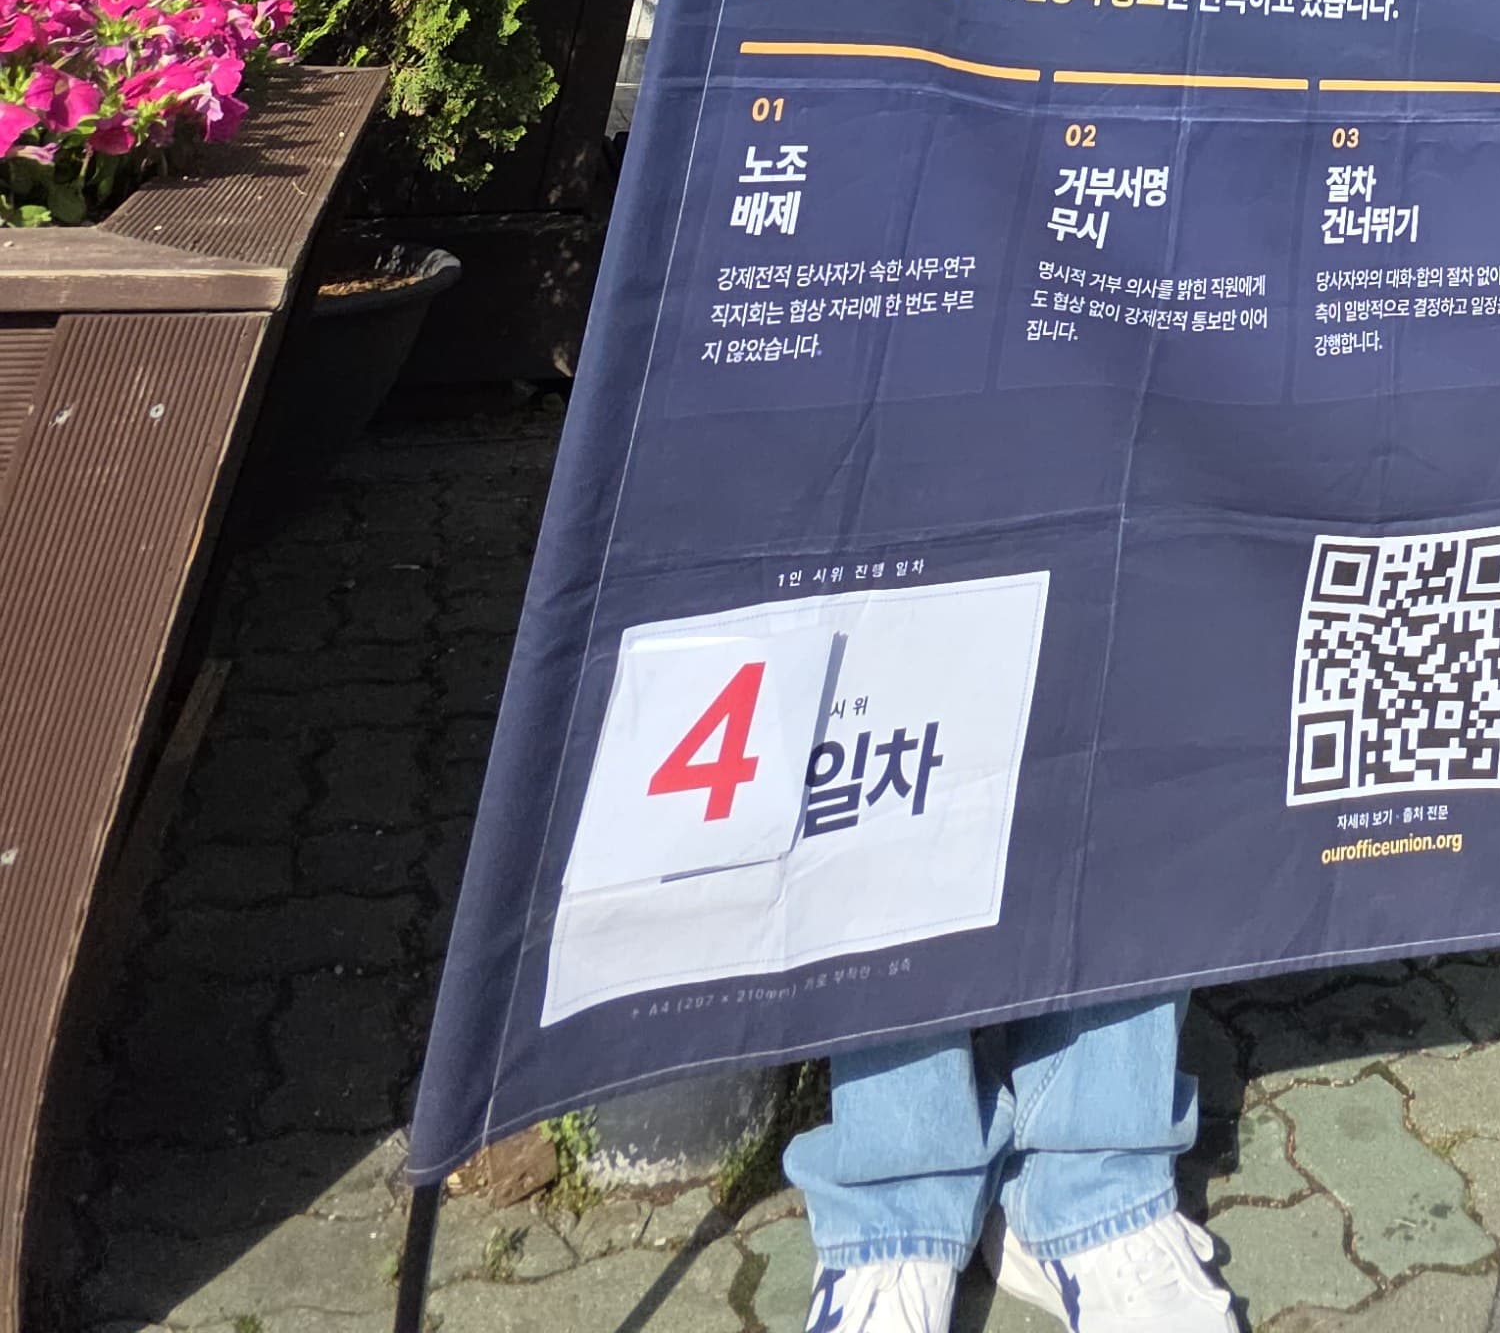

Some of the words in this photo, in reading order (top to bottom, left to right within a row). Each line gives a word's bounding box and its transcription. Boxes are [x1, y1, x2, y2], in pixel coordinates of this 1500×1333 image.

[751, 97, 784, 122] 01
[1065, 124, 1097, 148] 02
[1331, 128, 1360, 149] 03
[738, 144, 809, 184] 노조
[1054, 165, 1170, 208] 거부서명
[1325, 165, 1376, 204] 절차
[729, 190, 802, 236] 배제
[1047, 207, 1111, 250] 무시
[1320, 205, 1420, 245] 건너뛰기
[717, 263, 792, 291] 강제전적
[796, 261, 866, 290] 당사자가
[869, 258, 902, 284] 속한
[905, 255, 976, 279] 사무·연구
[1037, 260, 1086, 287] 명시적
[1089, 268, 1122, 295] 거부
[1125, 275, 1174, 301] 의사를
[1177, 276, 1208, 302] 밝힌
[1210, 273, 1267, 299] 직원에게
[1316, 267, 1383, 292] 당사자와의
[1385, 265, 1444, 290] 대화·합의
[1447, 265, 1474, 289] 절차
[711, 301, 785, 328] 직지회는
[789, 297, 827, 324] 협상
[828, 294, 881, 322] 자리에
[885, 293, 901, 319] 한
[905, 290, 938, 315] 번도
[941, 289, 975, 312] 부르
[1031, 290, 1050, 310] 도
[1053, 293, 1086, 315] 협상
[1089, 299, 1120, 323] 없이
[1125, 304, 1188, 332] 강제전적
[1191, 307, 1237, 332] 통보만
[1240, 305, 1268, 330] 이어
[1315, 299, 1342, 324] 측이
[1344, 297, 1410, 321] 일방적으로
[1413, 296, 1468, 318] 결정하고
[1026, 319, 1079, 343] 집니다.
[1314, 331, 1384, 356] 강행합니다.
[700, 339, 723, 365] 지
[725, 333, 823, 364] 않았습니다.
[778, 569, 802, 587] 1인
[813, 566, 844, 583] 시위
[855, 562, 886, 579] 진행
[896, 558, 925, 577] 일차
[830, 696, 869, 719] 시위
[646, 661, 767, 823] 4
[803, 721, 944, 839] 일차
[1336, 812, 1370, 830] 자세히
[1372, 809, 1393, 827] 보기
[1403, 806, 1424, 824] 출처
[1426, 804, 1449, 822] 전문
[1321, 833, 1463, 865] ourofficeunion.org
